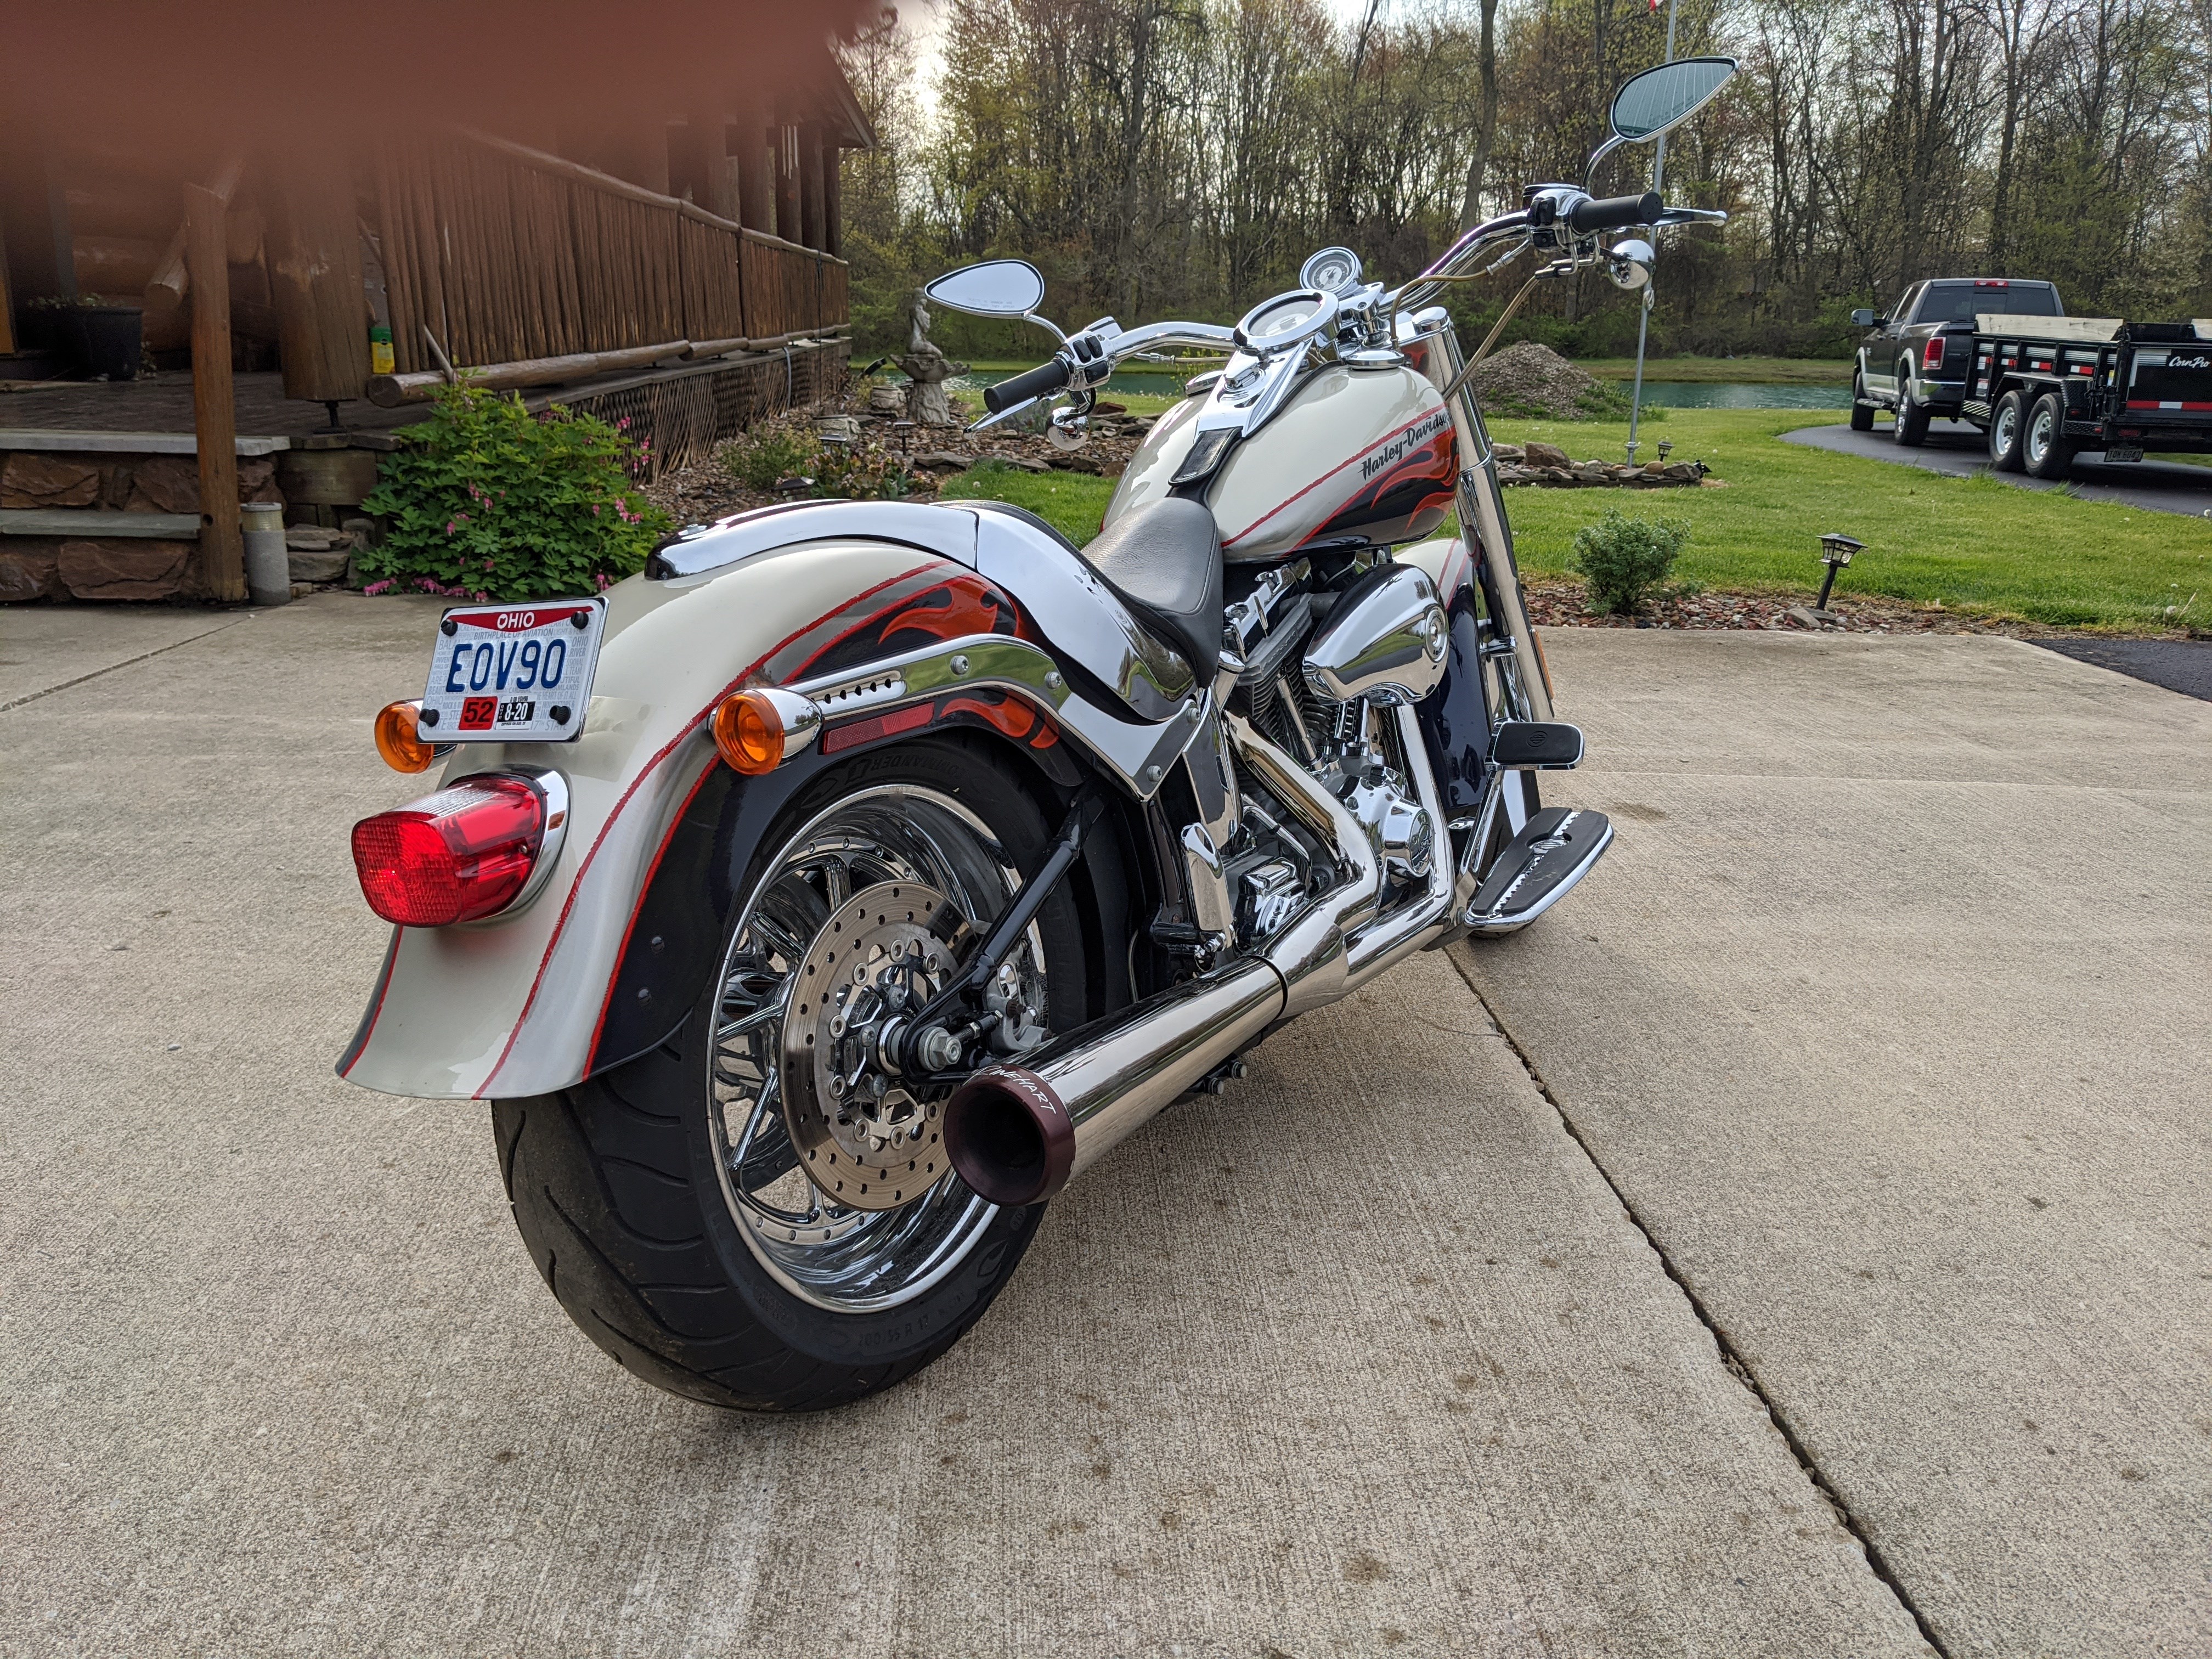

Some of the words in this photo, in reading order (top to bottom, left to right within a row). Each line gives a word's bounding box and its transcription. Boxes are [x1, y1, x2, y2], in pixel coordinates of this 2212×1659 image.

[2169, 356, 2211, 369] CornPro
[496, 612, 535, 629] OHIO
[473, 631, 511, 640] BIRTHPLACE
[522, 628, 554, 637] AVIATION
[572, 636, 589, 647] OHIO
[445, 639, 567, 692] EOV90
[464, 701, 494, 723] 52
[504, 702, 528, 721] 8-20
[962, 1065, 1057, 1115] RINEHART
